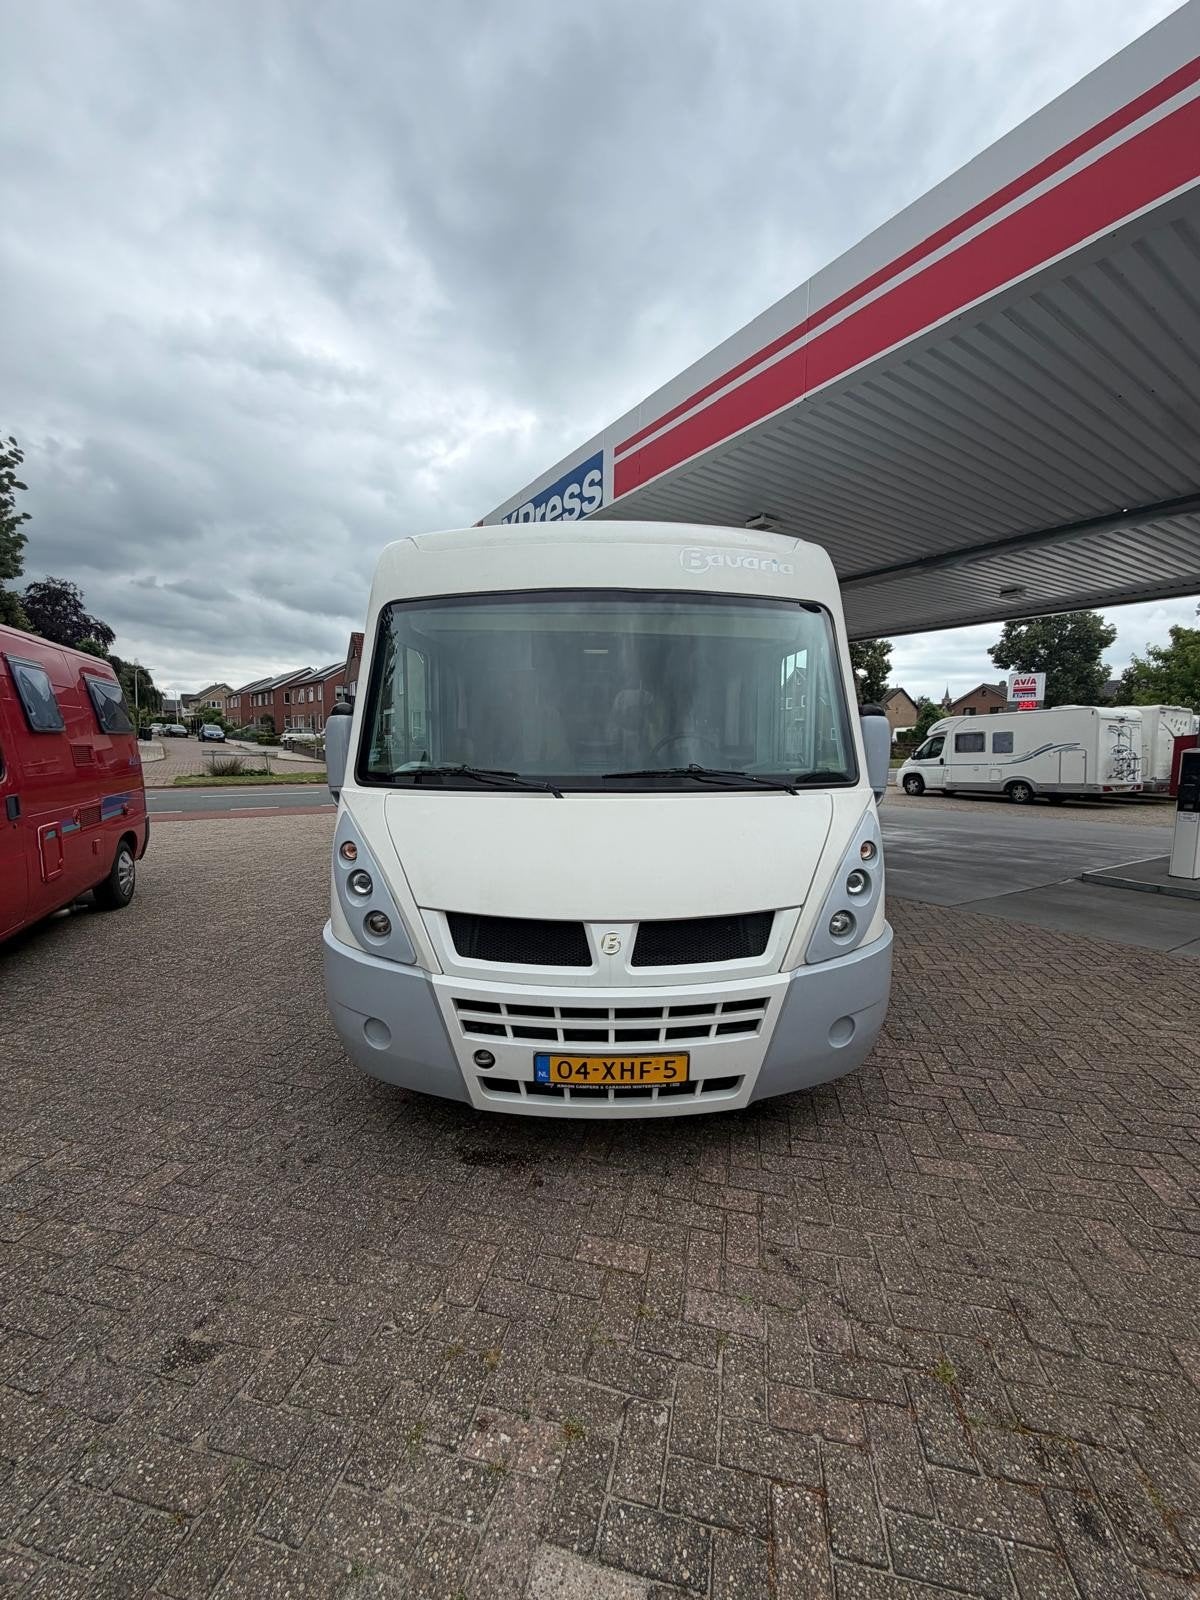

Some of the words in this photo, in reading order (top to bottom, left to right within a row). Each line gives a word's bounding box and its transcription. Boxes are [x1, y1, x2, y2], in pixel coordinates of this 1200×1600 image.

[502, 469, 602, 525] ress
[680, 546, 794, 574] Bavaria
[1013, 676, 1037, 686] AVIA
[556, 1060, 677, 1080] 04-XHF-5
